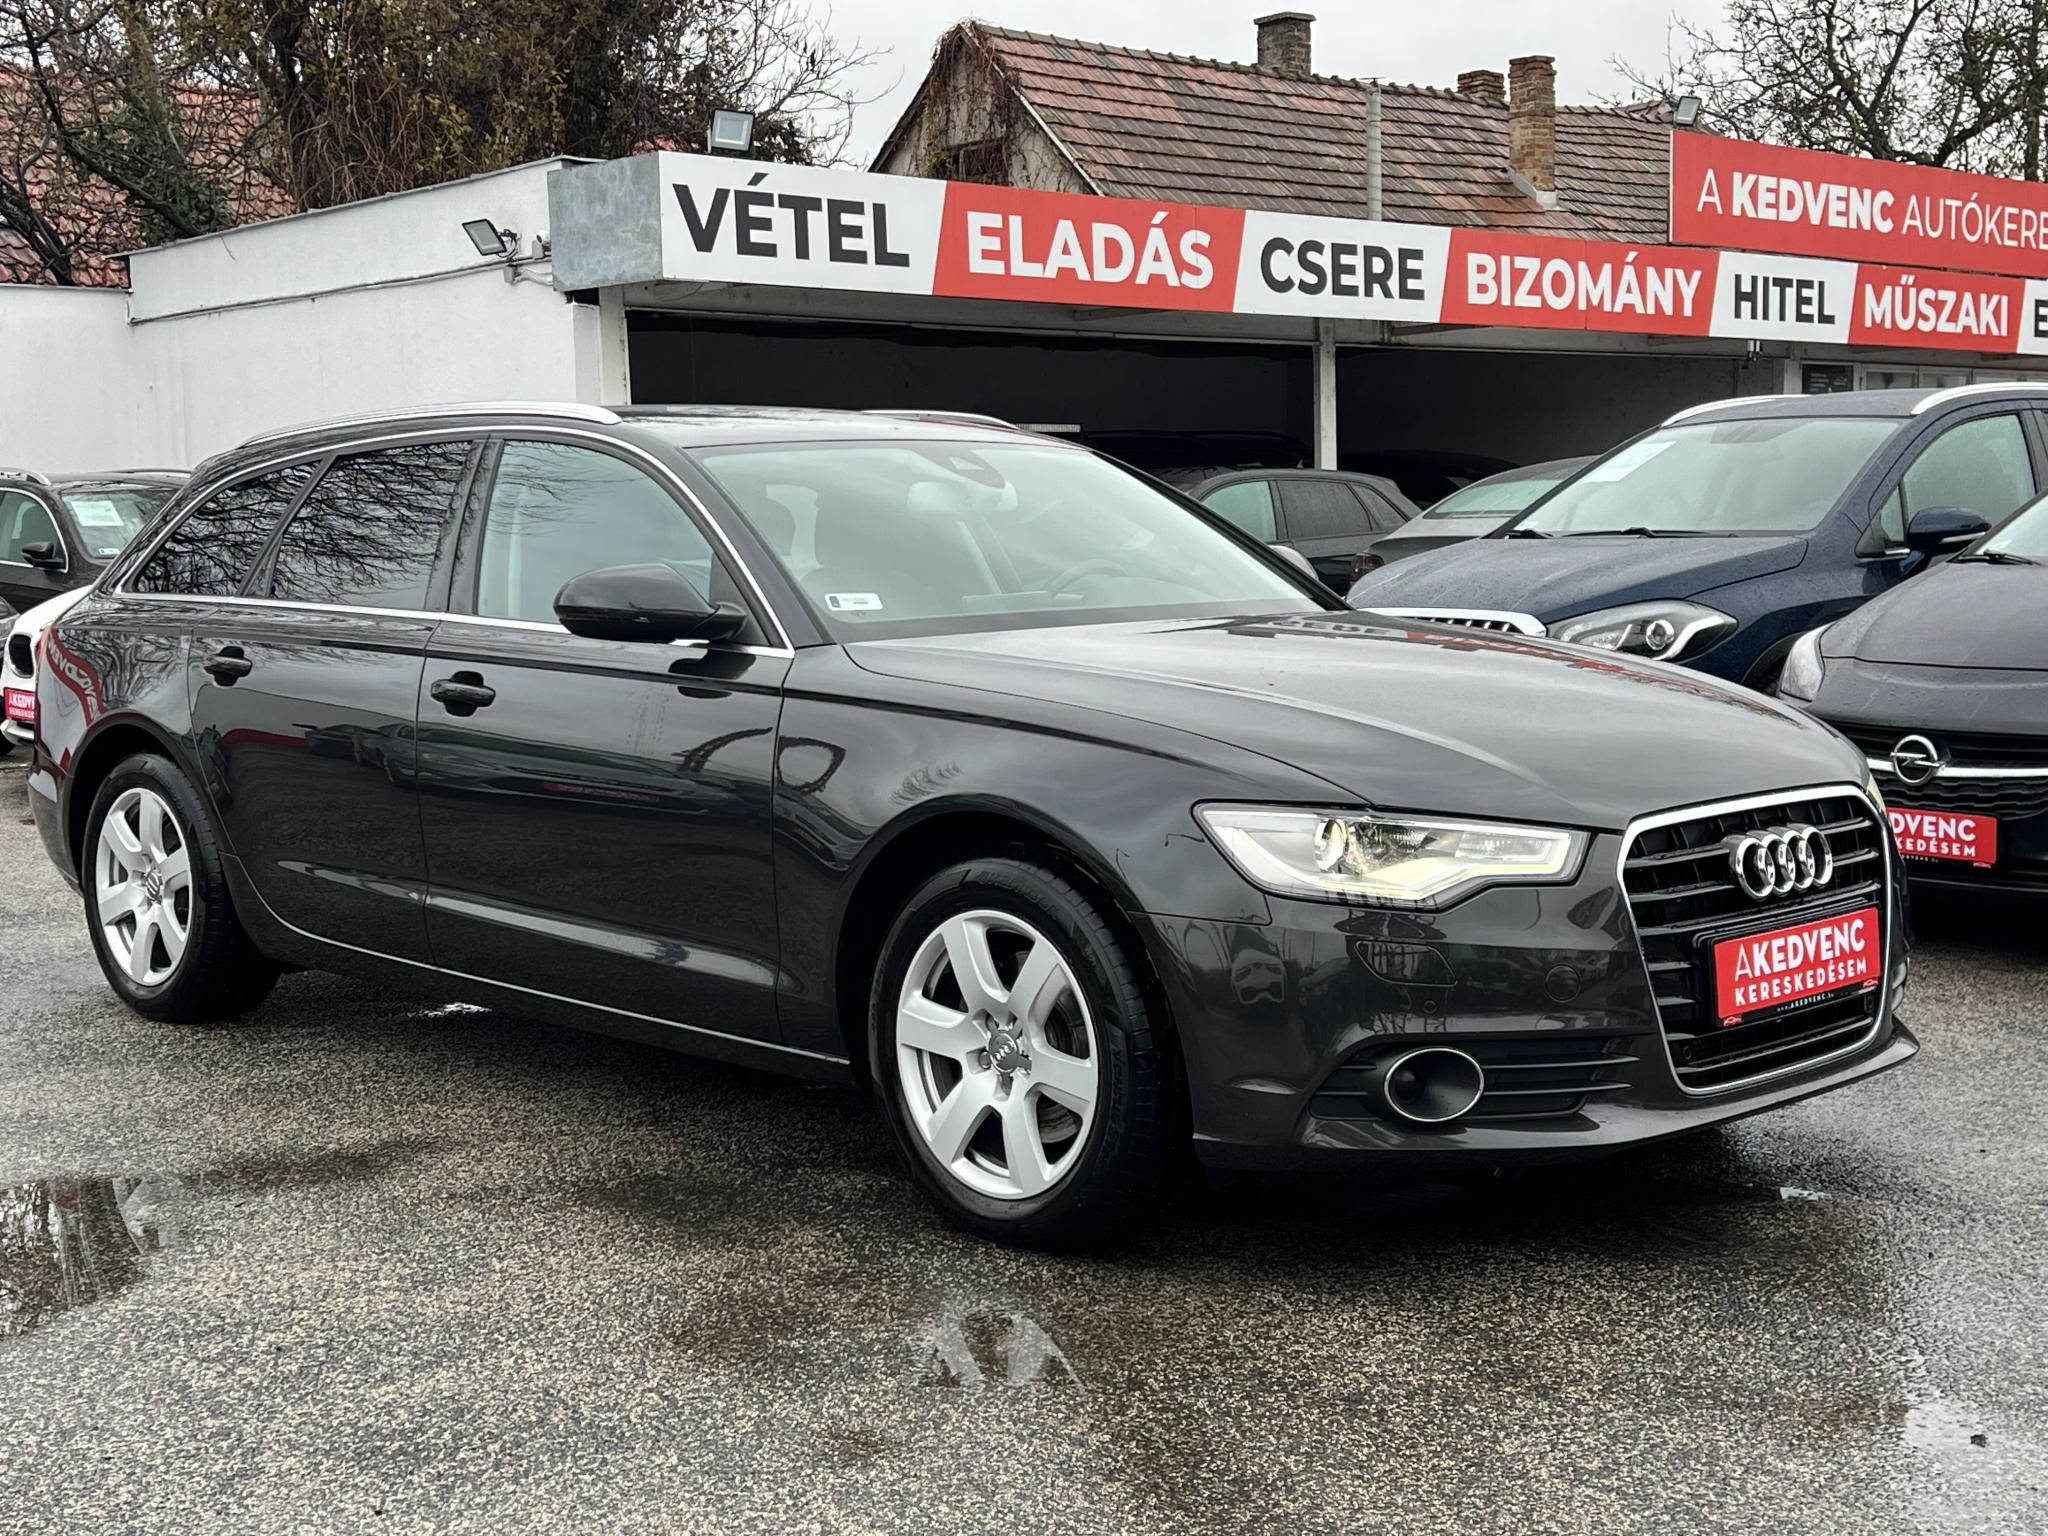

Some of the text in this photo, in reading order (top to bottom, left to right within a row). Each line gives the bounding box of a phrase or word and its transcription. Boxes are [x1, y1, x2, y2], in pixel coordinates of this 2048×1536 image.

[1697, 168, 1724, 214] A
[1731, 171, 1895, 234] KEDVENC
[672, 172, 910, 268] VÉTEL
[966, 211, 1214, 290] ELADÁS
[1260, 237, 1426, 301] CSERE
[1466, 251, 1703, 317] BIZOMÁNY
[1733, 273, 1836, 325] HITEL
[1863, 274, 2009, 337] MŰSZAKI
[1735, 956, 1867, 1007] KERESKEDÉSEM
